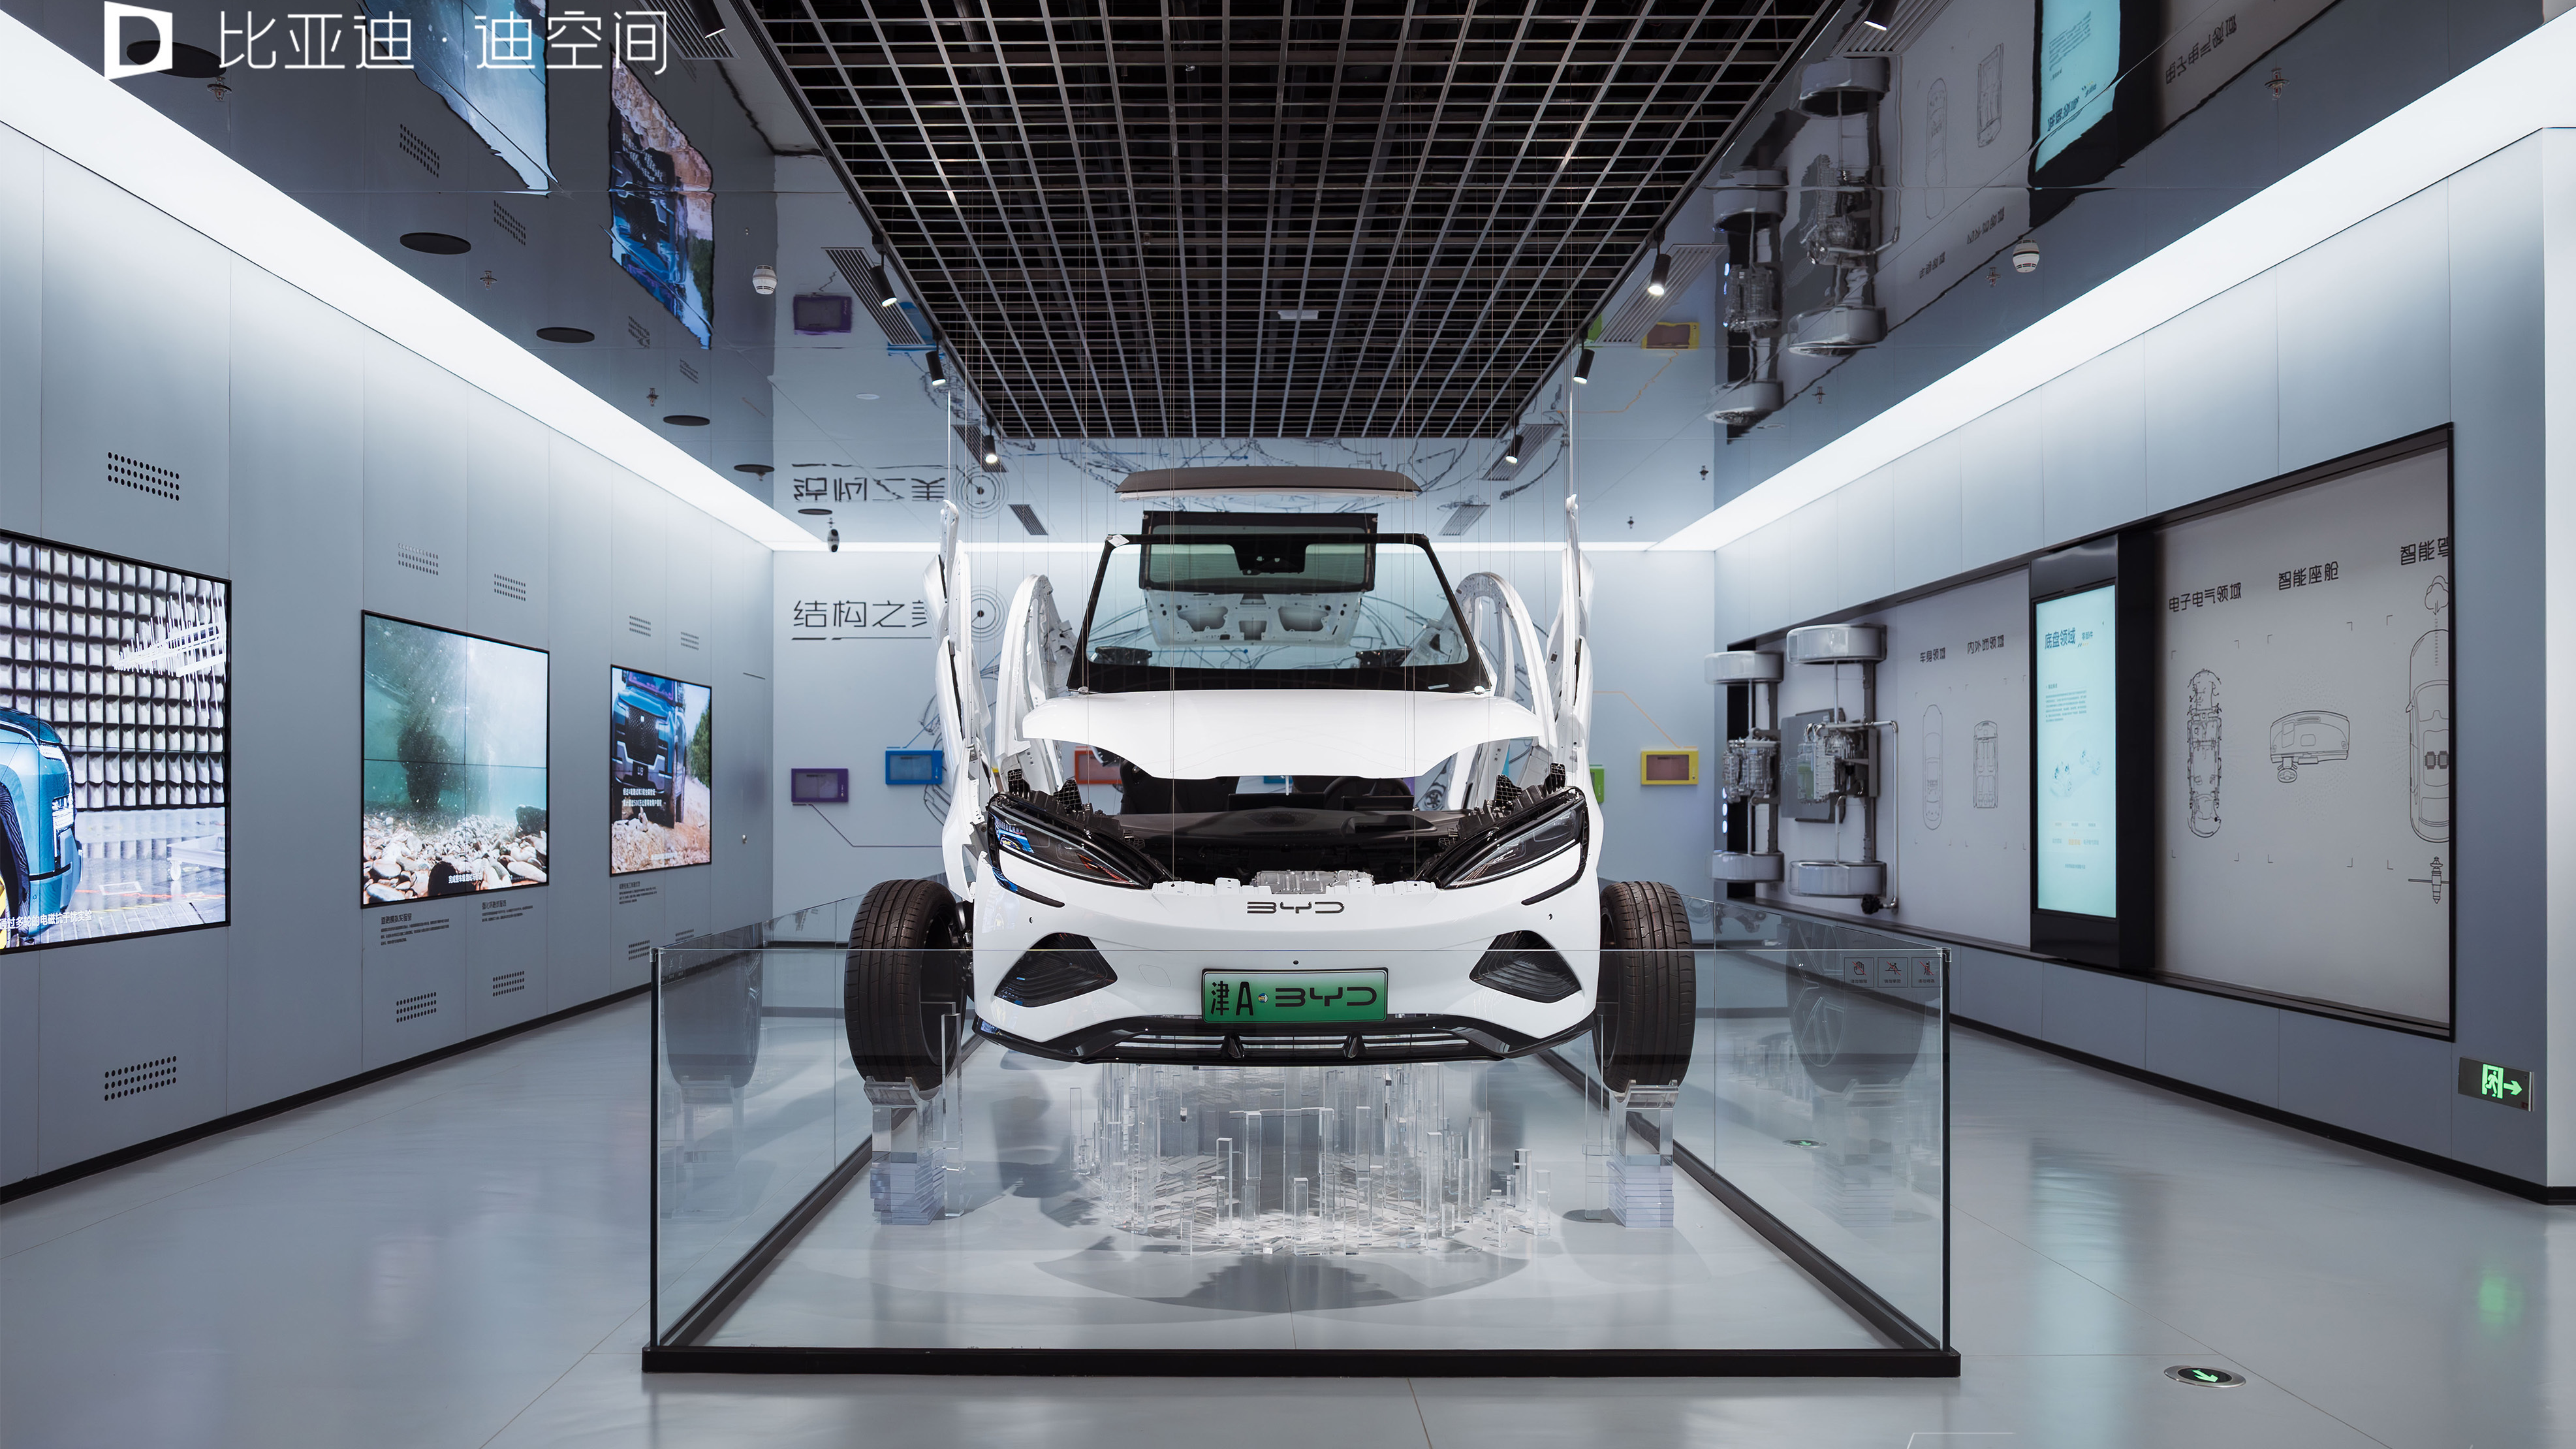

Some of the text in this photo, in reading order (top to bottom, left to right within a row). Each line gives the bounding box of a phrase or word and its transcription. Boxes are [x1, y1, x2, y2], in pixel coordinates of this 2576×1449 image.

[2278, 561, 2339, 591] 智能座舱
[2169, 582, 2242, 613] 电子电气领域
[1967, 634, 2004, 655] 内外饰领域
[2045, 627, 2076, 650] 底盘领域
[1919, 647, 1945, 663] 车身领域
[1247, 901, 1345, 914] BYD
